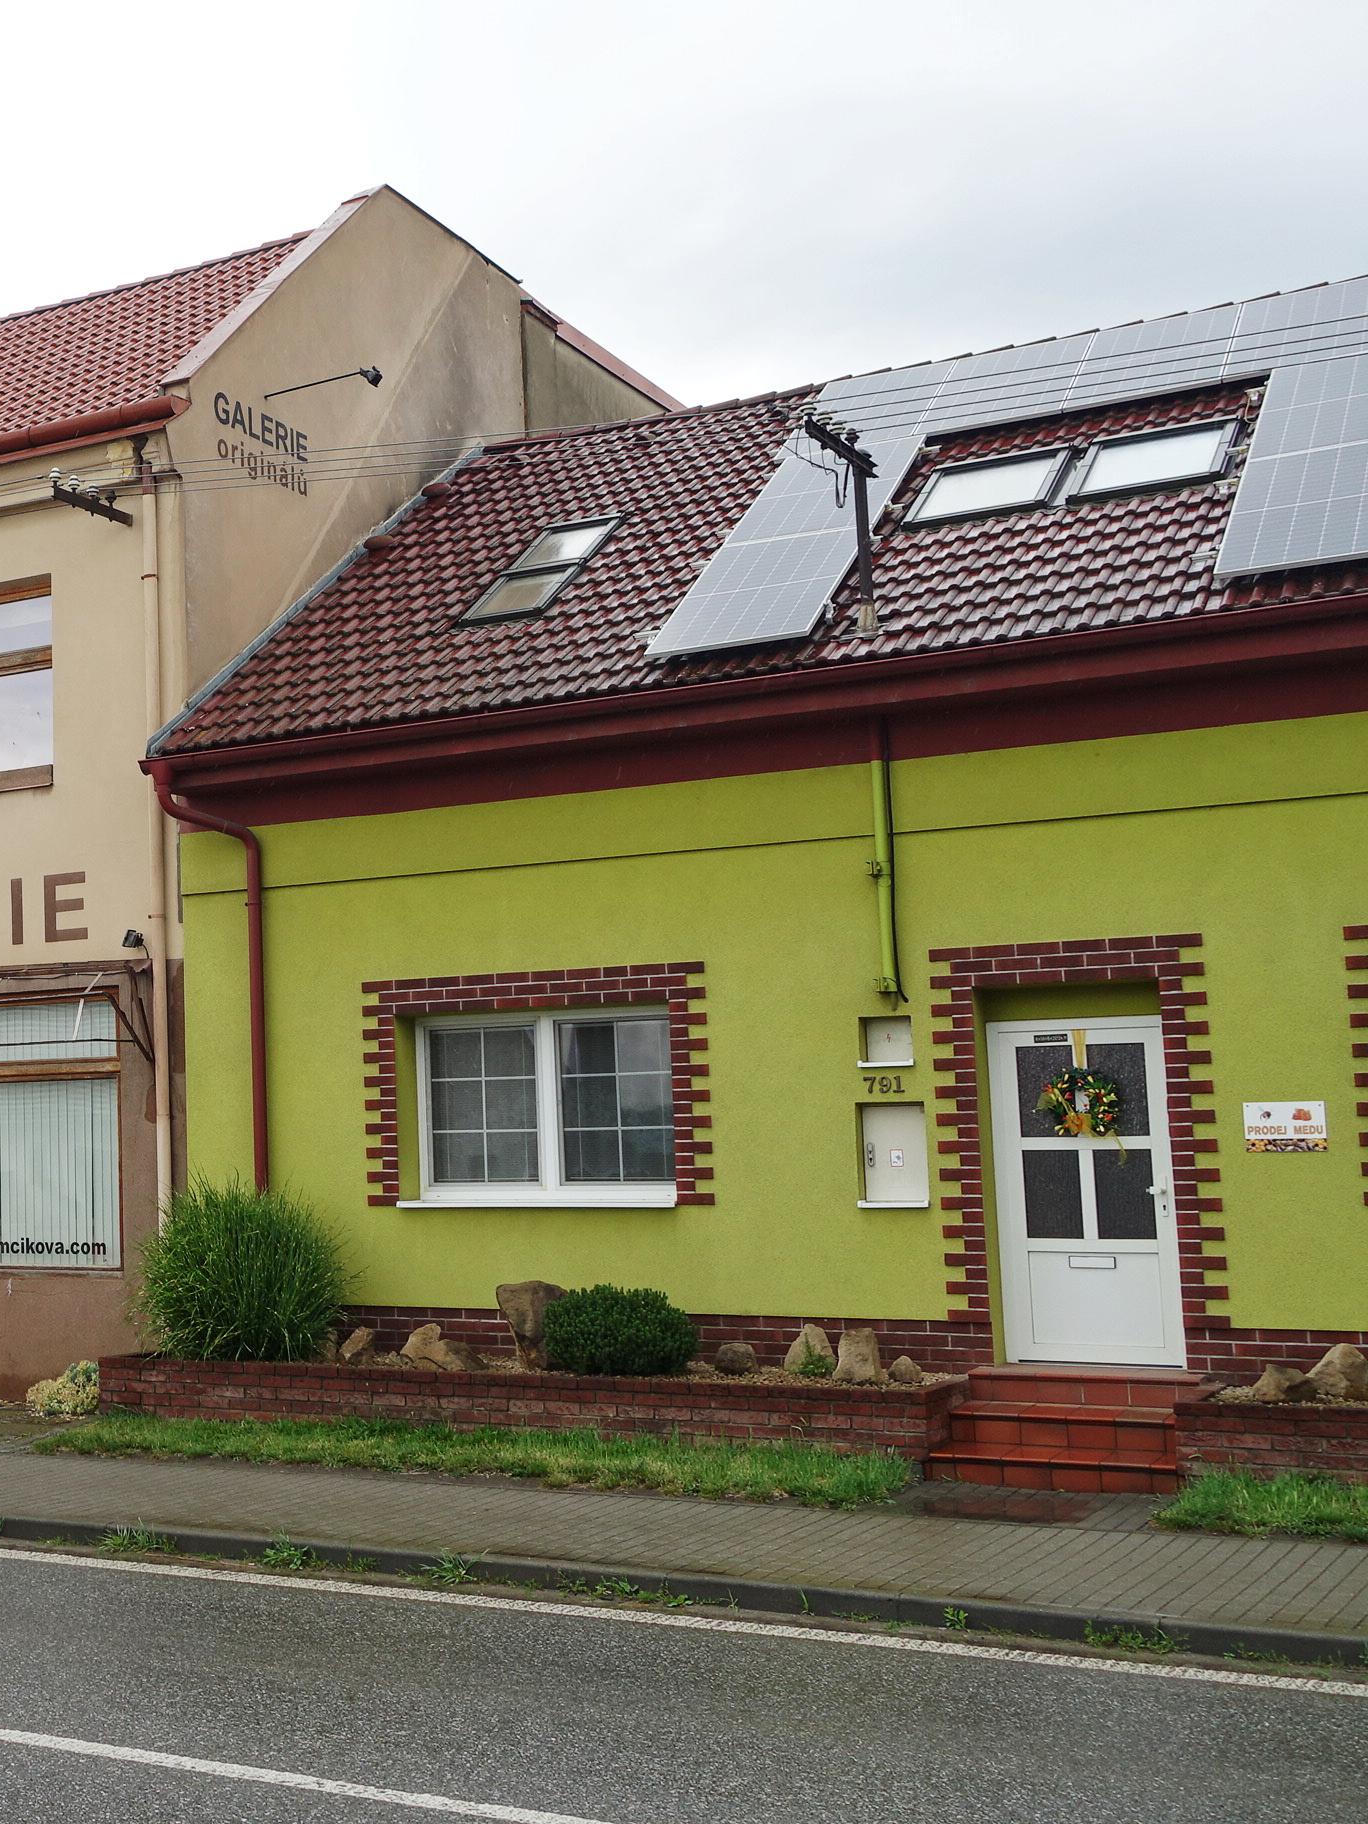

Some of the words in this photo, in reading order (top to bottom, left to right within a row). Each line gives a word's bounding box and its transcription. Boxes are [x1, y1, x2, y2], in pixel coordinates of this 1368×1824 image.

[214, 392, 308, 462] GALERIE
[863, 1076, 905, 1094] 791
[1247, 1125, 1287, 1136] PRODEJ
[1293, 1124, 1323, 1135] MEDU
